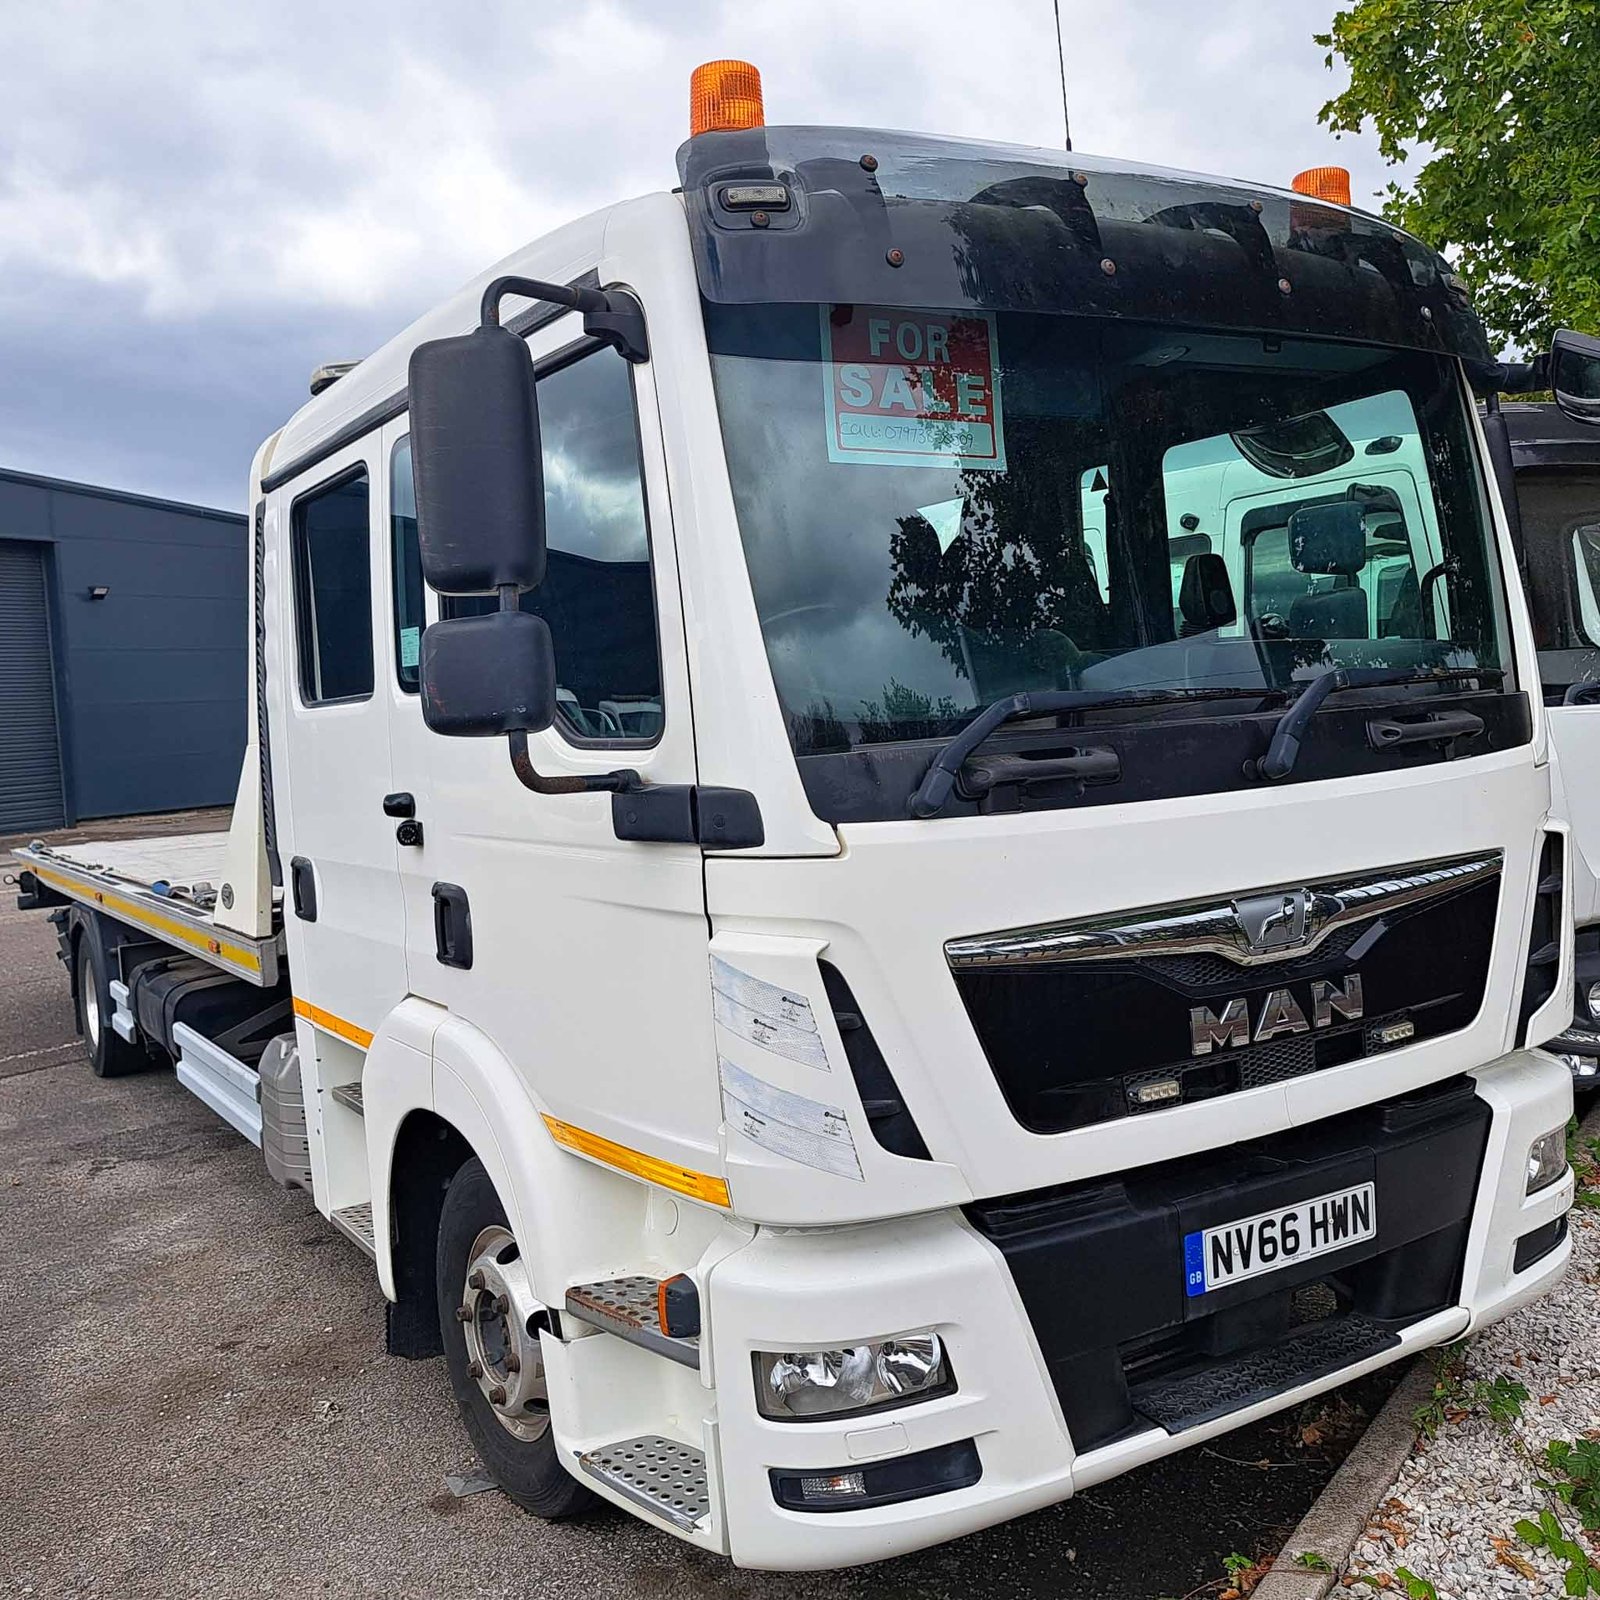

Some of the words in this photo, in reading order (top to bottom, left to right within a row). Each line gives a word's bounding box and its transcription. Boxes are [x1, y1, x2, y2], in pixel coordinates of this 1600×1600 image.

[869, 318, 950, 363] FOR
[839, 364, 987, 416] SALE
[1190, 973, 1363, 1055] MAN
[1211, 1212, 1300, 1279] NV66
[1309, 1190, 1371, 1248] HWN
[1189, 1270, 1202, 1285] GB
